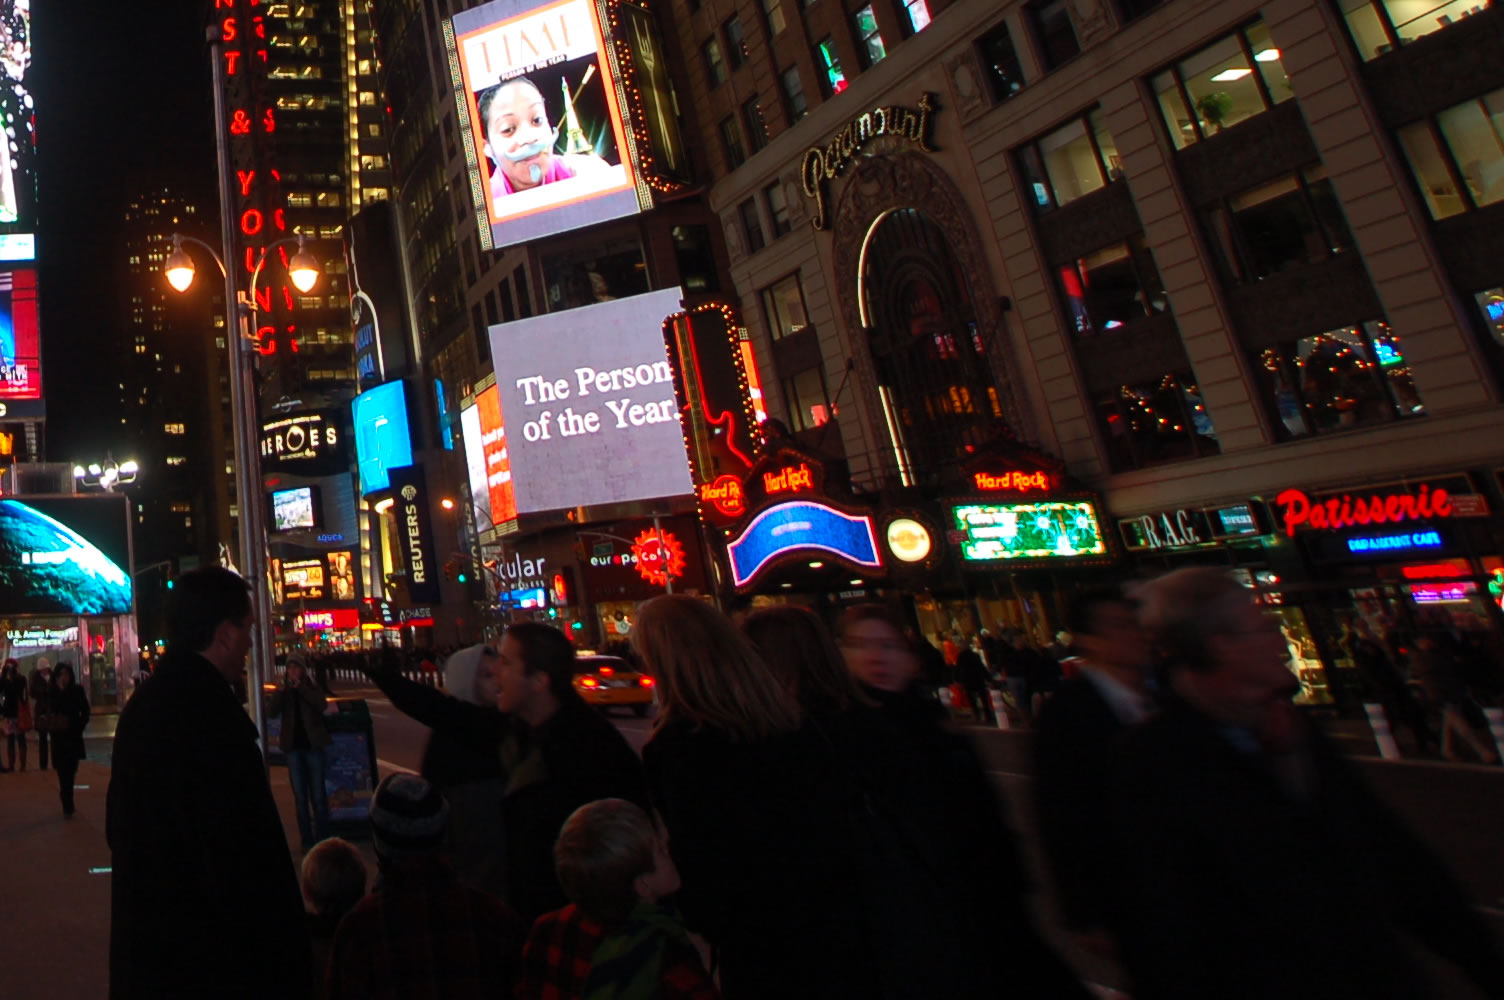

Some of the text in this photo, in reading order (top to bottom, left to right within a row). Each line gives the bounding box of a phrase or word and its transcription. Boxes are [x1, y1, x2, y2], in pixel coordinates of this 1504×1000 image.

[801, 92, 934, 231] Paramount
[517, 360, 674, 405] The Person
[523, 398, 682, 442] of the Year.
[701, 482, 728, 500] Hard
[764, 462, 814, 494] Hard Rock
[974, 470, 1049, 493] Hard Rock
[1138, 508, 1201, 549] R.A.G.
[1276, 483, 1453, 537] Patisserie
[405, 503, 425, 583] REUTERS
[1412, 531, 1442, 546] CAFE
[405, 607, 431, 618] CHASE
